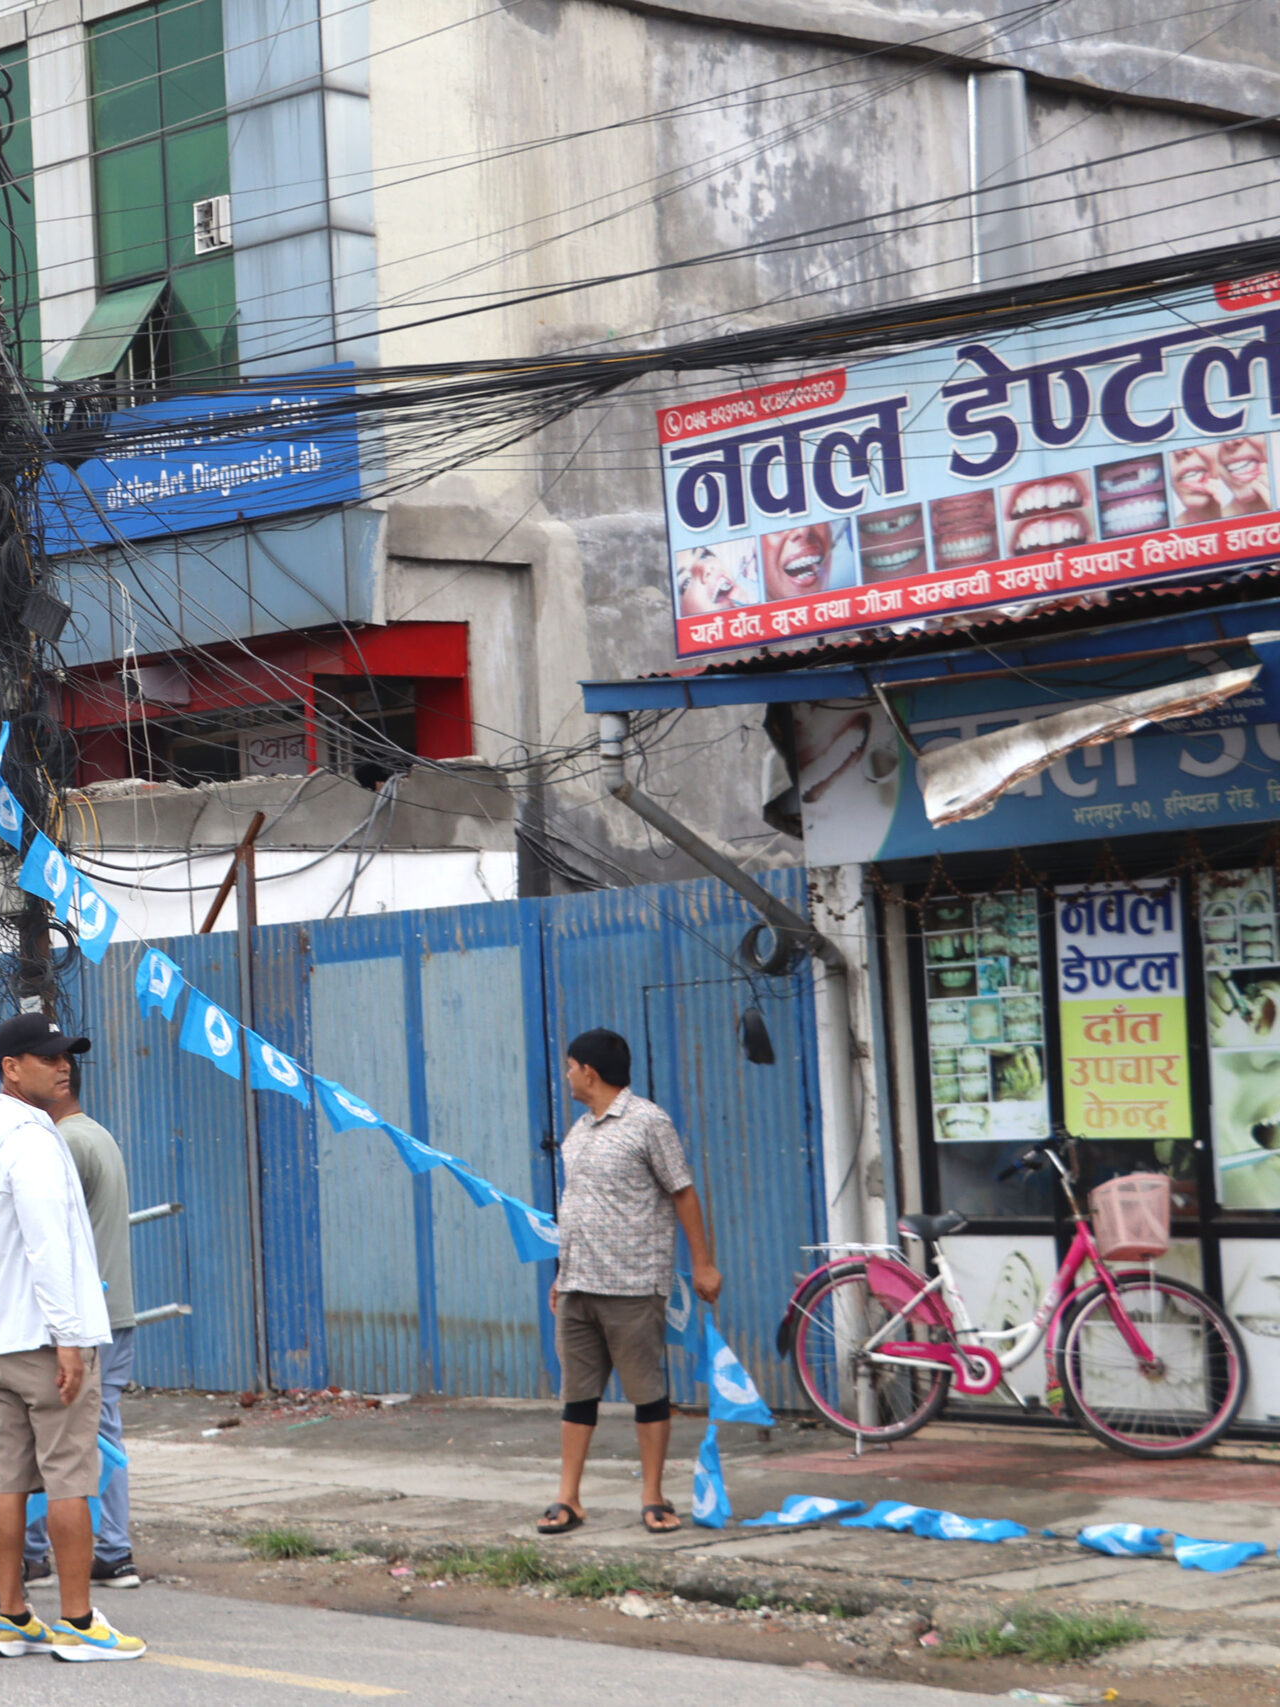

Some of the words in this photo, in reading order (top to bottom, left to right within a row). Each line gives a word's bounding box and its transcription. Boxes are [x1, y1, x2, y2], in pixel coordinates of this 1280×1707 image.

[669, 393, 910, 533] नवल
[941, 306, 1280, 481] डेण्टल
[192, 448, 283, 497] Diagnostic
[289, 442, 321, 475] Lab
[690, 615, 724, 644] यहाँ
[771, 604, 809, 635] मुख
[814, 598, 851, 623] तथा
[855, 589, 903, 616] गीजा
[908, 569, 991, 607] सम्बन्धी
[996, 552, 1065, 591] सम्पूर्ण
[1069, 547, 1136, 579] उपचार
[1141, 529, 1219, 567] विशेषज्ञ
[1060, 888, 1176, 937] नवल
[1062, 945, 1180, 994] डेण्टल
[1082, 1003, 1164, 1046] दाँत
[1067, 1055, 1181, 1087] उपचार
[1082, 1092, 1170, 1134] केन्द्र
